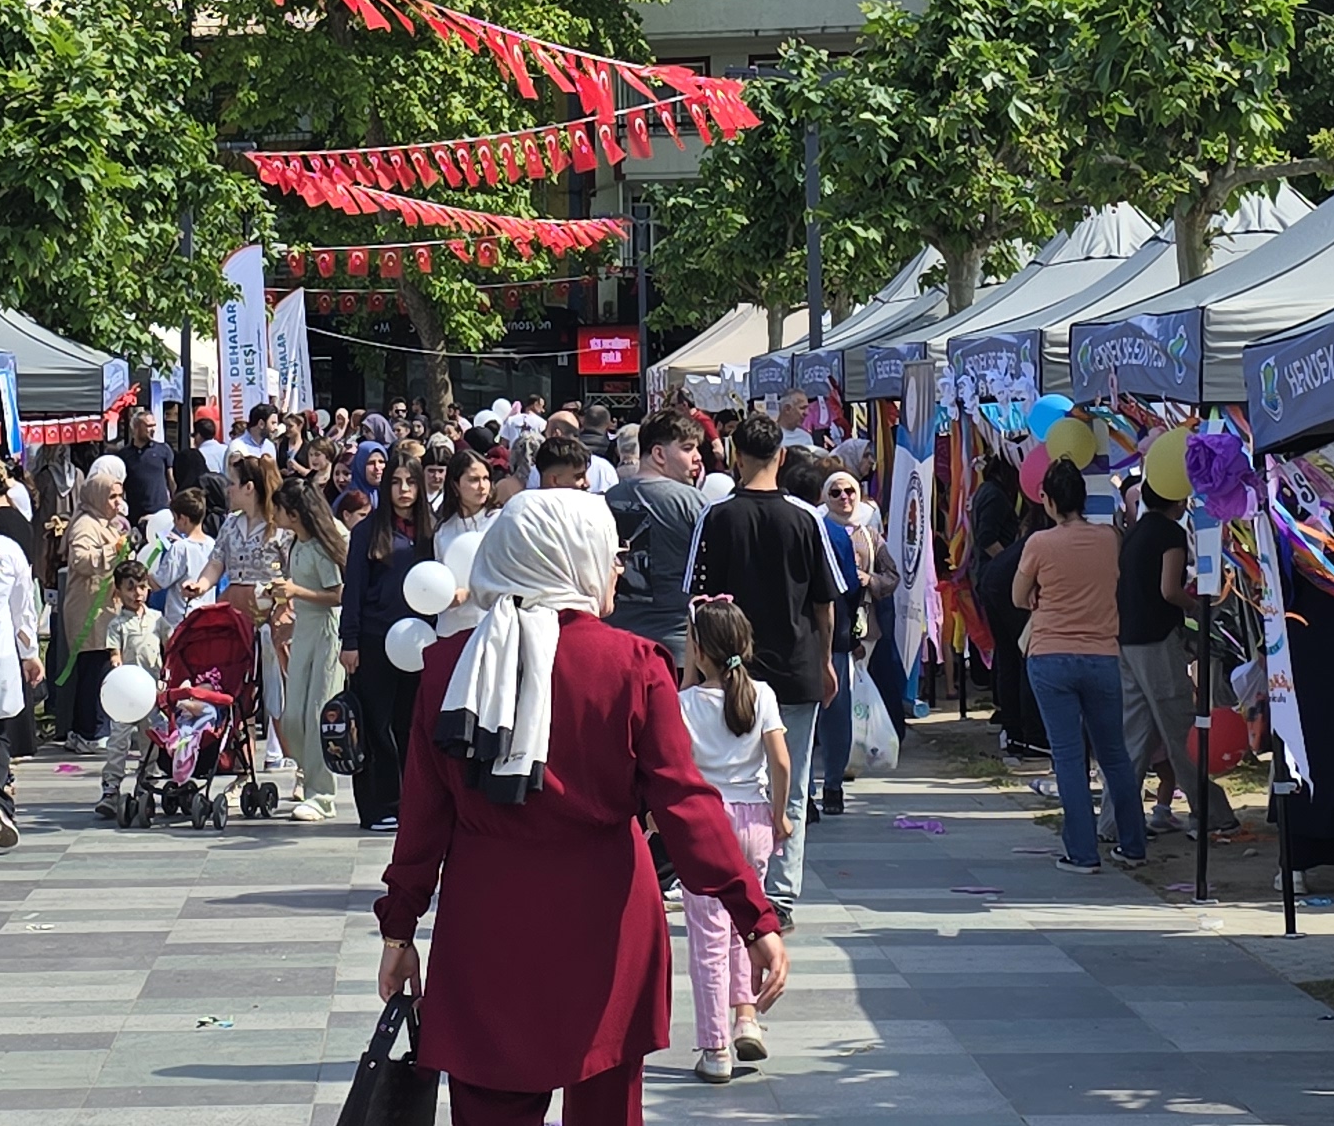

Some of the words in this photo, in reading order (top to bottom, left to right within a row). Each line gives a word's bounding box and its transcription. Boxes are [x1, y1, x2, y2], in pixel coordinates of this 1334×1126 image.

[225, 303, 240, 378] DEHALAR
[240, 343, 257, 387] KREŞİ
[276, 331, 288, 386] DEHALAR
